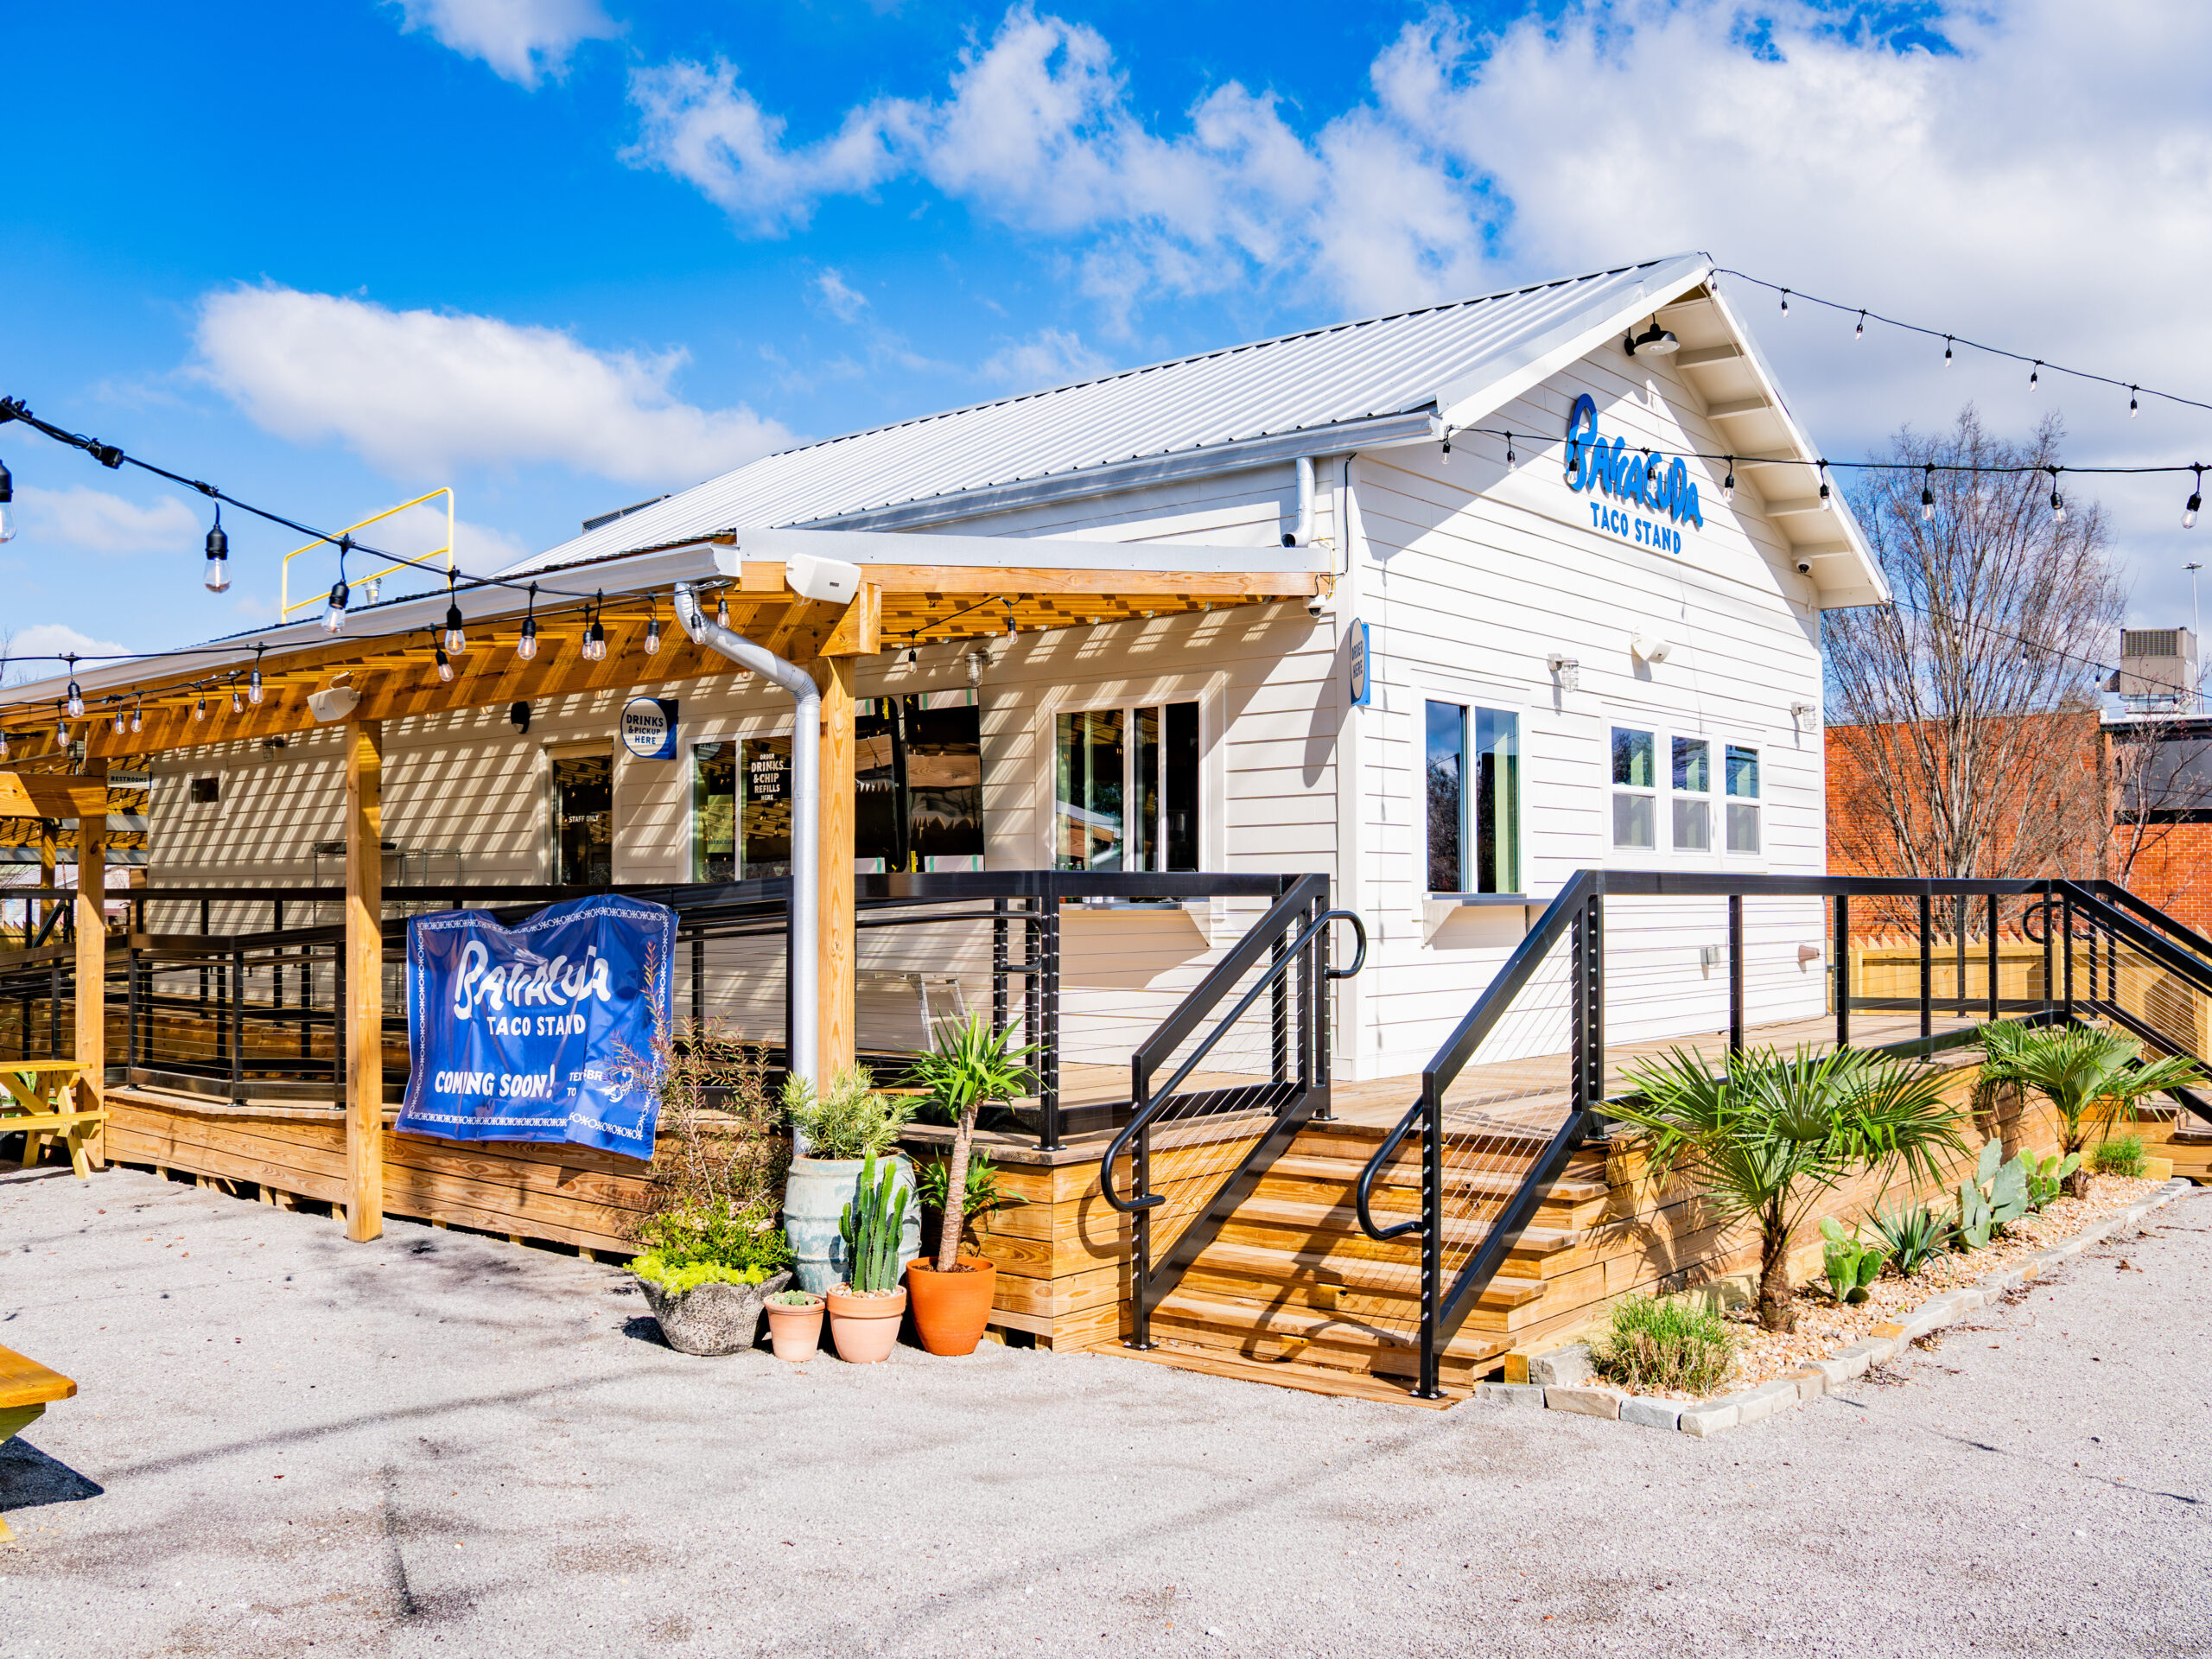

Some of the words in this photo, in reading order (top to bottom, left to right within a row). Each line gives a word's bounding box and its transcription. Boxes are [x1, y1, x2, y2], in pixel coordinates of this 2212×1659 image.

[1591, 502, 1628, 537] TACO
[1635, 518, 1681, 554] STAND
[1353, 659, 1363, 678] HERE
[626, 714, 664, 727] DRINKS
[635, 735, 656, 745] HERE
[751, 760, 784, 772] DRINKS
[754, 784, 780, 793] REFILLS
[486, 1016, 531, 1036] TACO
[435, 1071, 495, 1096] COMING
[499, 1064, 556, 1099] SOON!
[567, 1087, 577, 1096] TO
